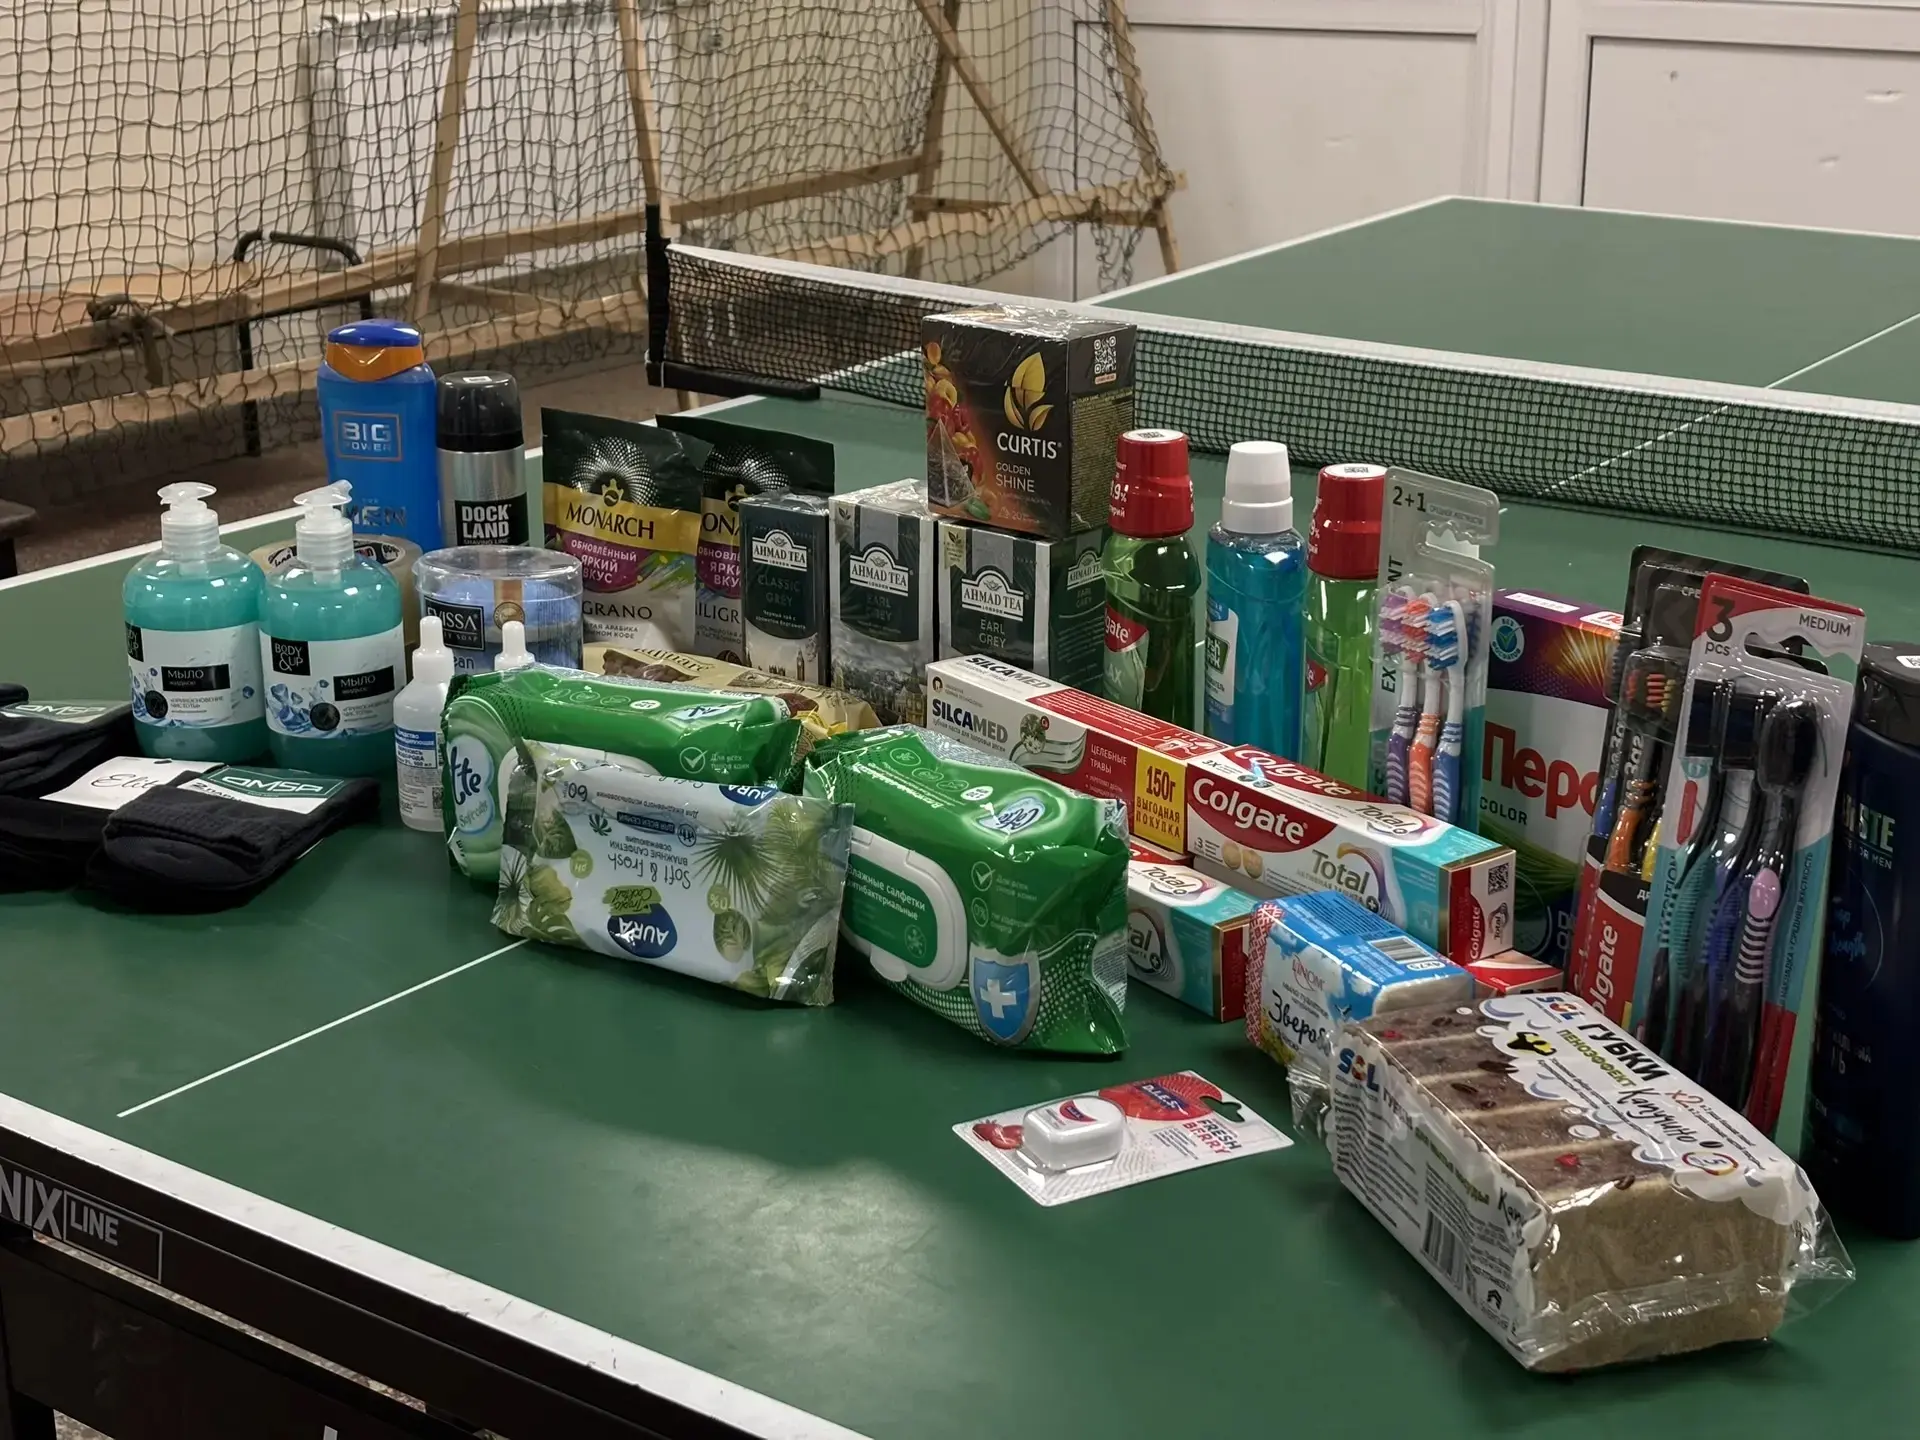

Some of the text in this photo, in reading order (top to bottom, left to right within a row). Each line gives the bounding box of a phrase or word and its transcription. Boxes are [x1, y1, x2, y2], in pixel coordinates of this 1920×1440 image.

[341, 421, 391, 442] BIG
[997, 431, 1058, 459] CURTIS
[996, 462, 1031, 476] GOLDEN
[996, 475, 1035, 493] SHINE
[1392, 485, 1426, 512] 2+1
[461, 504, 509, 522] DOCK
[565, 502, 654, 540] MONARCH
[463, 521, 509, 539] LAND
[571, 539, 637, 562] ОБНОВЛЁННЫЙ
[754, 545, 806, 564] AHMAD TEA
[581, 554, 618, 573] ЯРКИЙ
[710, 562, 741, 576] ЯРКИ
[714, 575, 741, 588] ВКУ
[758, 574, 801, 592] CLASSIC
[851, 564, 907, 587] AHMAD TEA
[582, 601, 653, 620] GRANO
[765, 592, 793, 607] GREY
[963, 587, 1022, 612] AHMAD TEA
[980, 618, 1006, 635] EARL
[1706, 596, 1736, 642] 3
[1799, 613, 1852, 637] MEDIUM
[274, 642, 303, 658] BODY
[979, 634, 1006, 648] GREY
[1705, 640, 1731, 656] pcs
[167, 669, 204, 679] МЫЛО
[340, 674, 376, 688] МЫЛО
[965, 656, 1051, 690] SILCAMED
[932, 698, 1009, 743] SILCAMED
[1090, 758, 1112, 774] ТРАВЫ
[1091, 744, 1127, 766] ЦЕЛЕБНЫЕ
[1146, 765, 1176, 802] 150г
[1234, 749, 1352, 796] Colgate
[568, 782, 588, 801] 60
[1136, 796, 1180, 823] ВЫГОДНАЯ
[1192, 778, 1305, 845] Colgate
[1355, 804, 1416, 828] Total
[1479, 796, 1528, 825] COLOR
[1136, 810, 1180, 839] ПОКУПКА
[609, 839, 688, 866] ВЛАЖНЫЕ САЛФЕТКИ
[650, 864, 659, 882] &
[664, 866, 691, 889] Soft
[1142, 866, 1196, 888] Total
[1311, 849, 1371, 895] Total
[614, 887, 653, 900] Cocktail
[886, 883, 926, 912] салфетки
[618, 916, 670, 947] AURA
[1470, 906, 1481, 959] Colgate
[1590, 922, 1618, 1019] olgate
[1556, 1029, 1637, 1088] ПЕНОЭФФЕКТ
[1578, 1022, 1670, 1082] ГУБКИ
[1337, 1047, 1380, 1093] SOL
[1664, 1089, 1704, 1108] x2
[1617, 1087, 1699, 1144] Капучино
[1182, 1121, 1231, 1154] BERRY
[1197, 1119, 1242, 1150] FRESH
[70, 1200, 119, 1246] LINE
